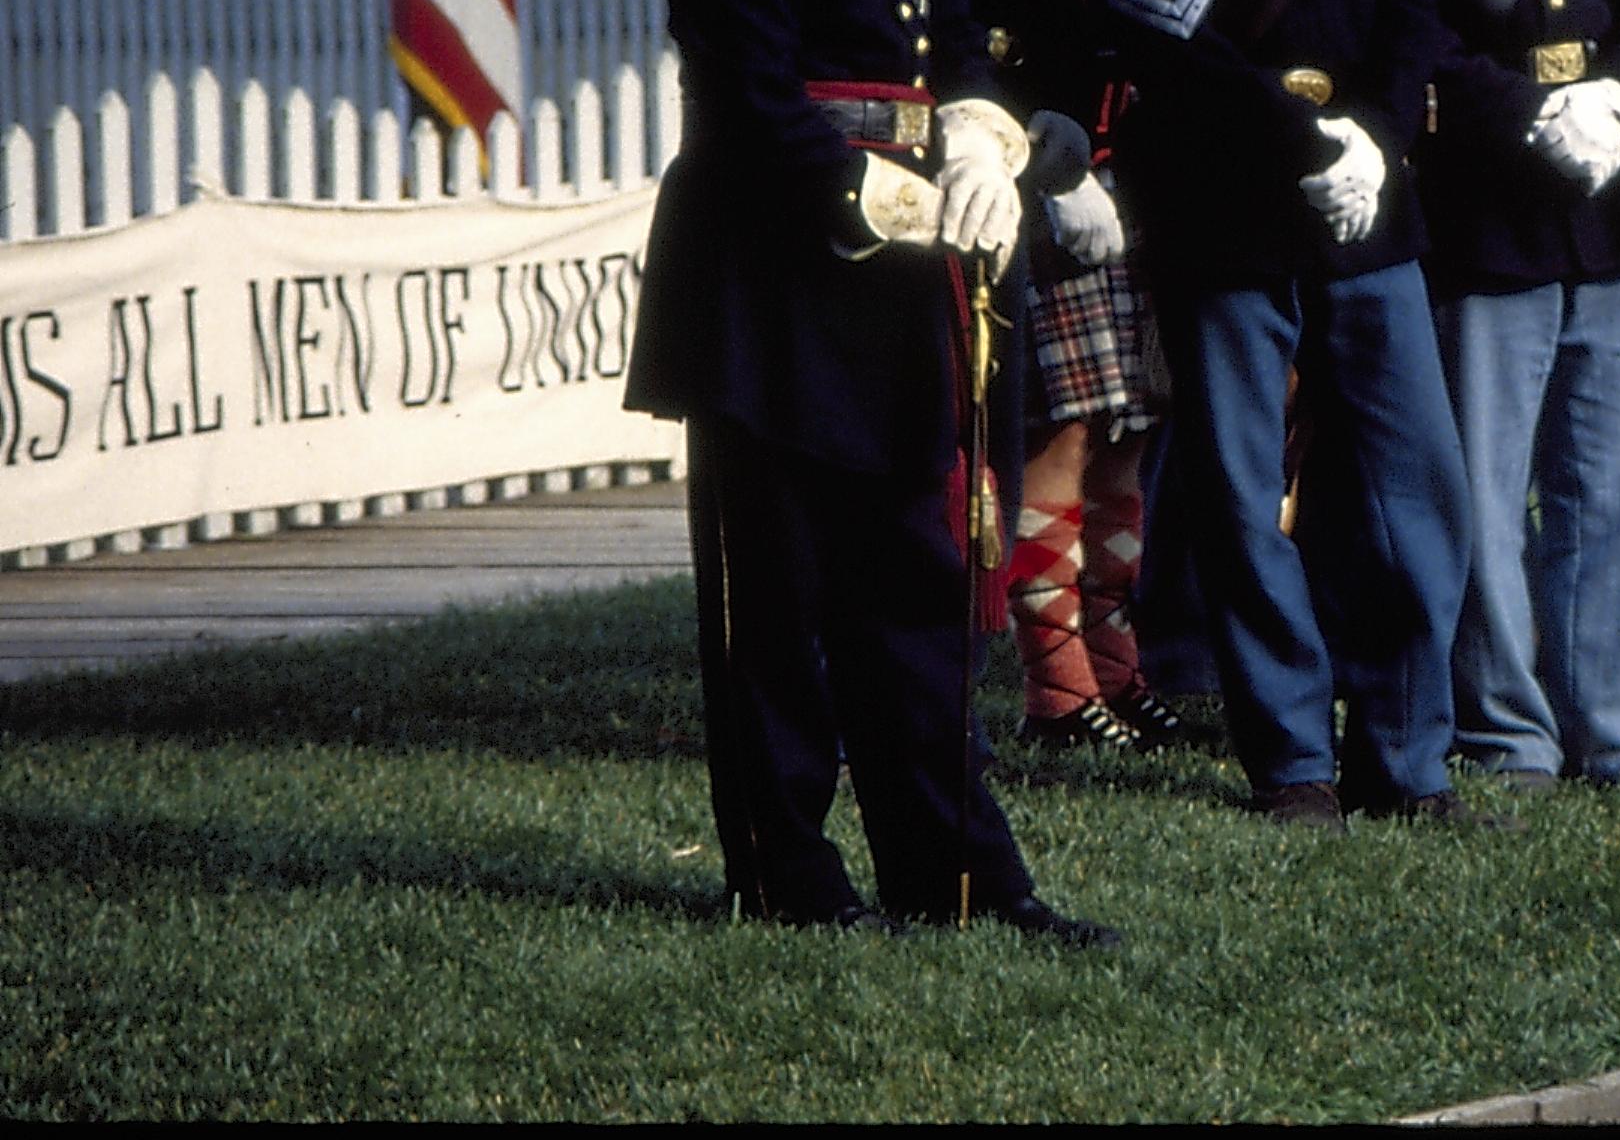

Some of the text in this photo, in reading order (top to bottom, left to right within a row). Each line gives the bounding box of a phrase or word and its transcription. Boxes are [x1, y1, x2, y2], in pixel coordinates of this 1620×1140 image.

[0, 250, 643, 464] IS ALL MEN OF UNIO
